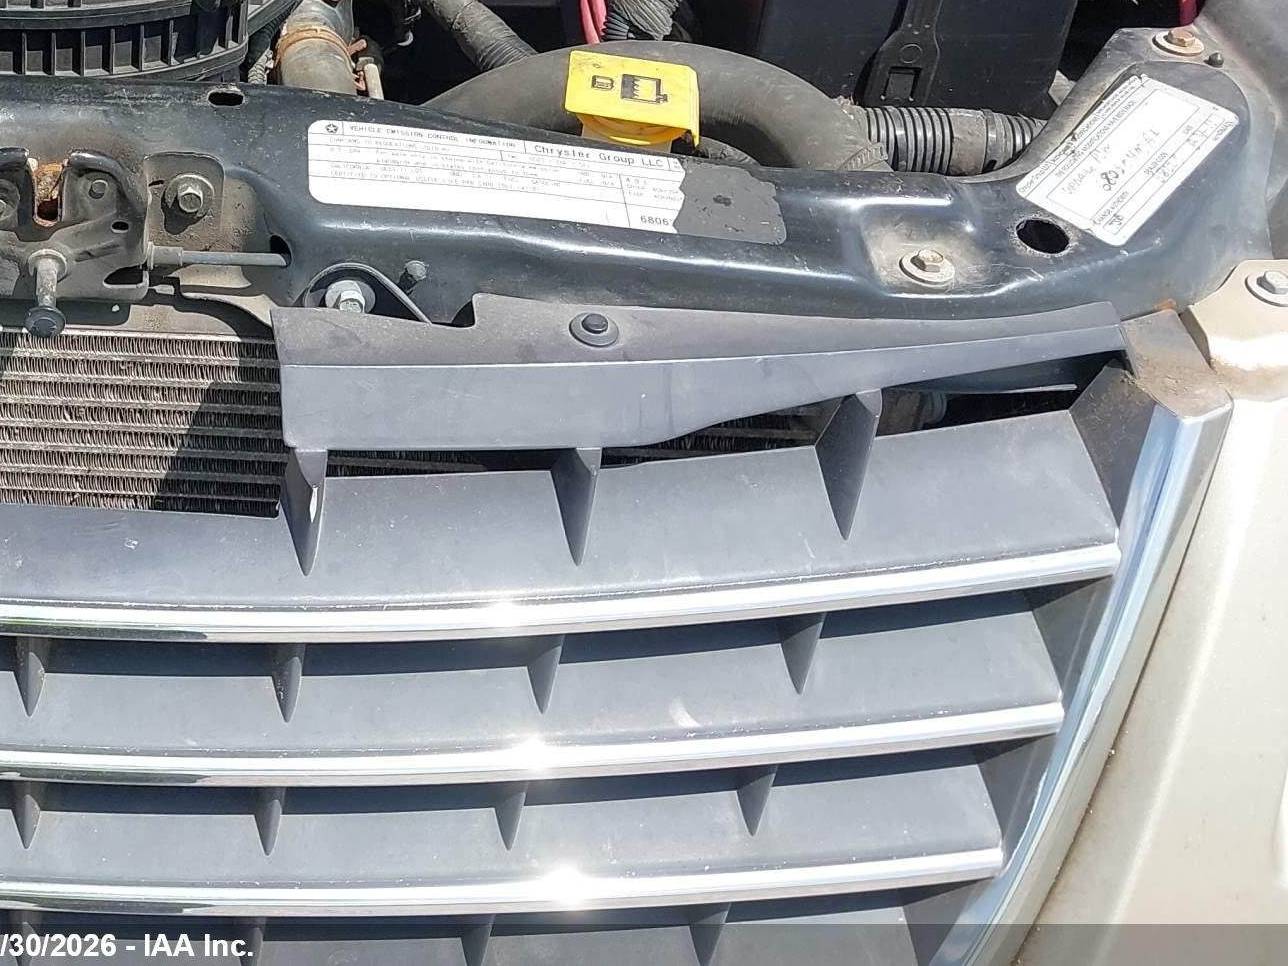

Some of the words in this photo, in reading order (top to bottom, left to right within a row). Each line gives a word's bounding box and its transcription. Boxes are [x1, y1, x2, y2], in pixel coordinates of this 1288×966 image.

[350, 125, 382, 134] VEHICLE
[386, 128, 424, 139] EMISSION
[465, 137, 517, 148] INFORMATION
[534, 145, 590, 159] Chrysler
[599, 153, 635, 166] Group
[641, 157, 664, 168] LLC
[640, 215, 672, 226] 6806
